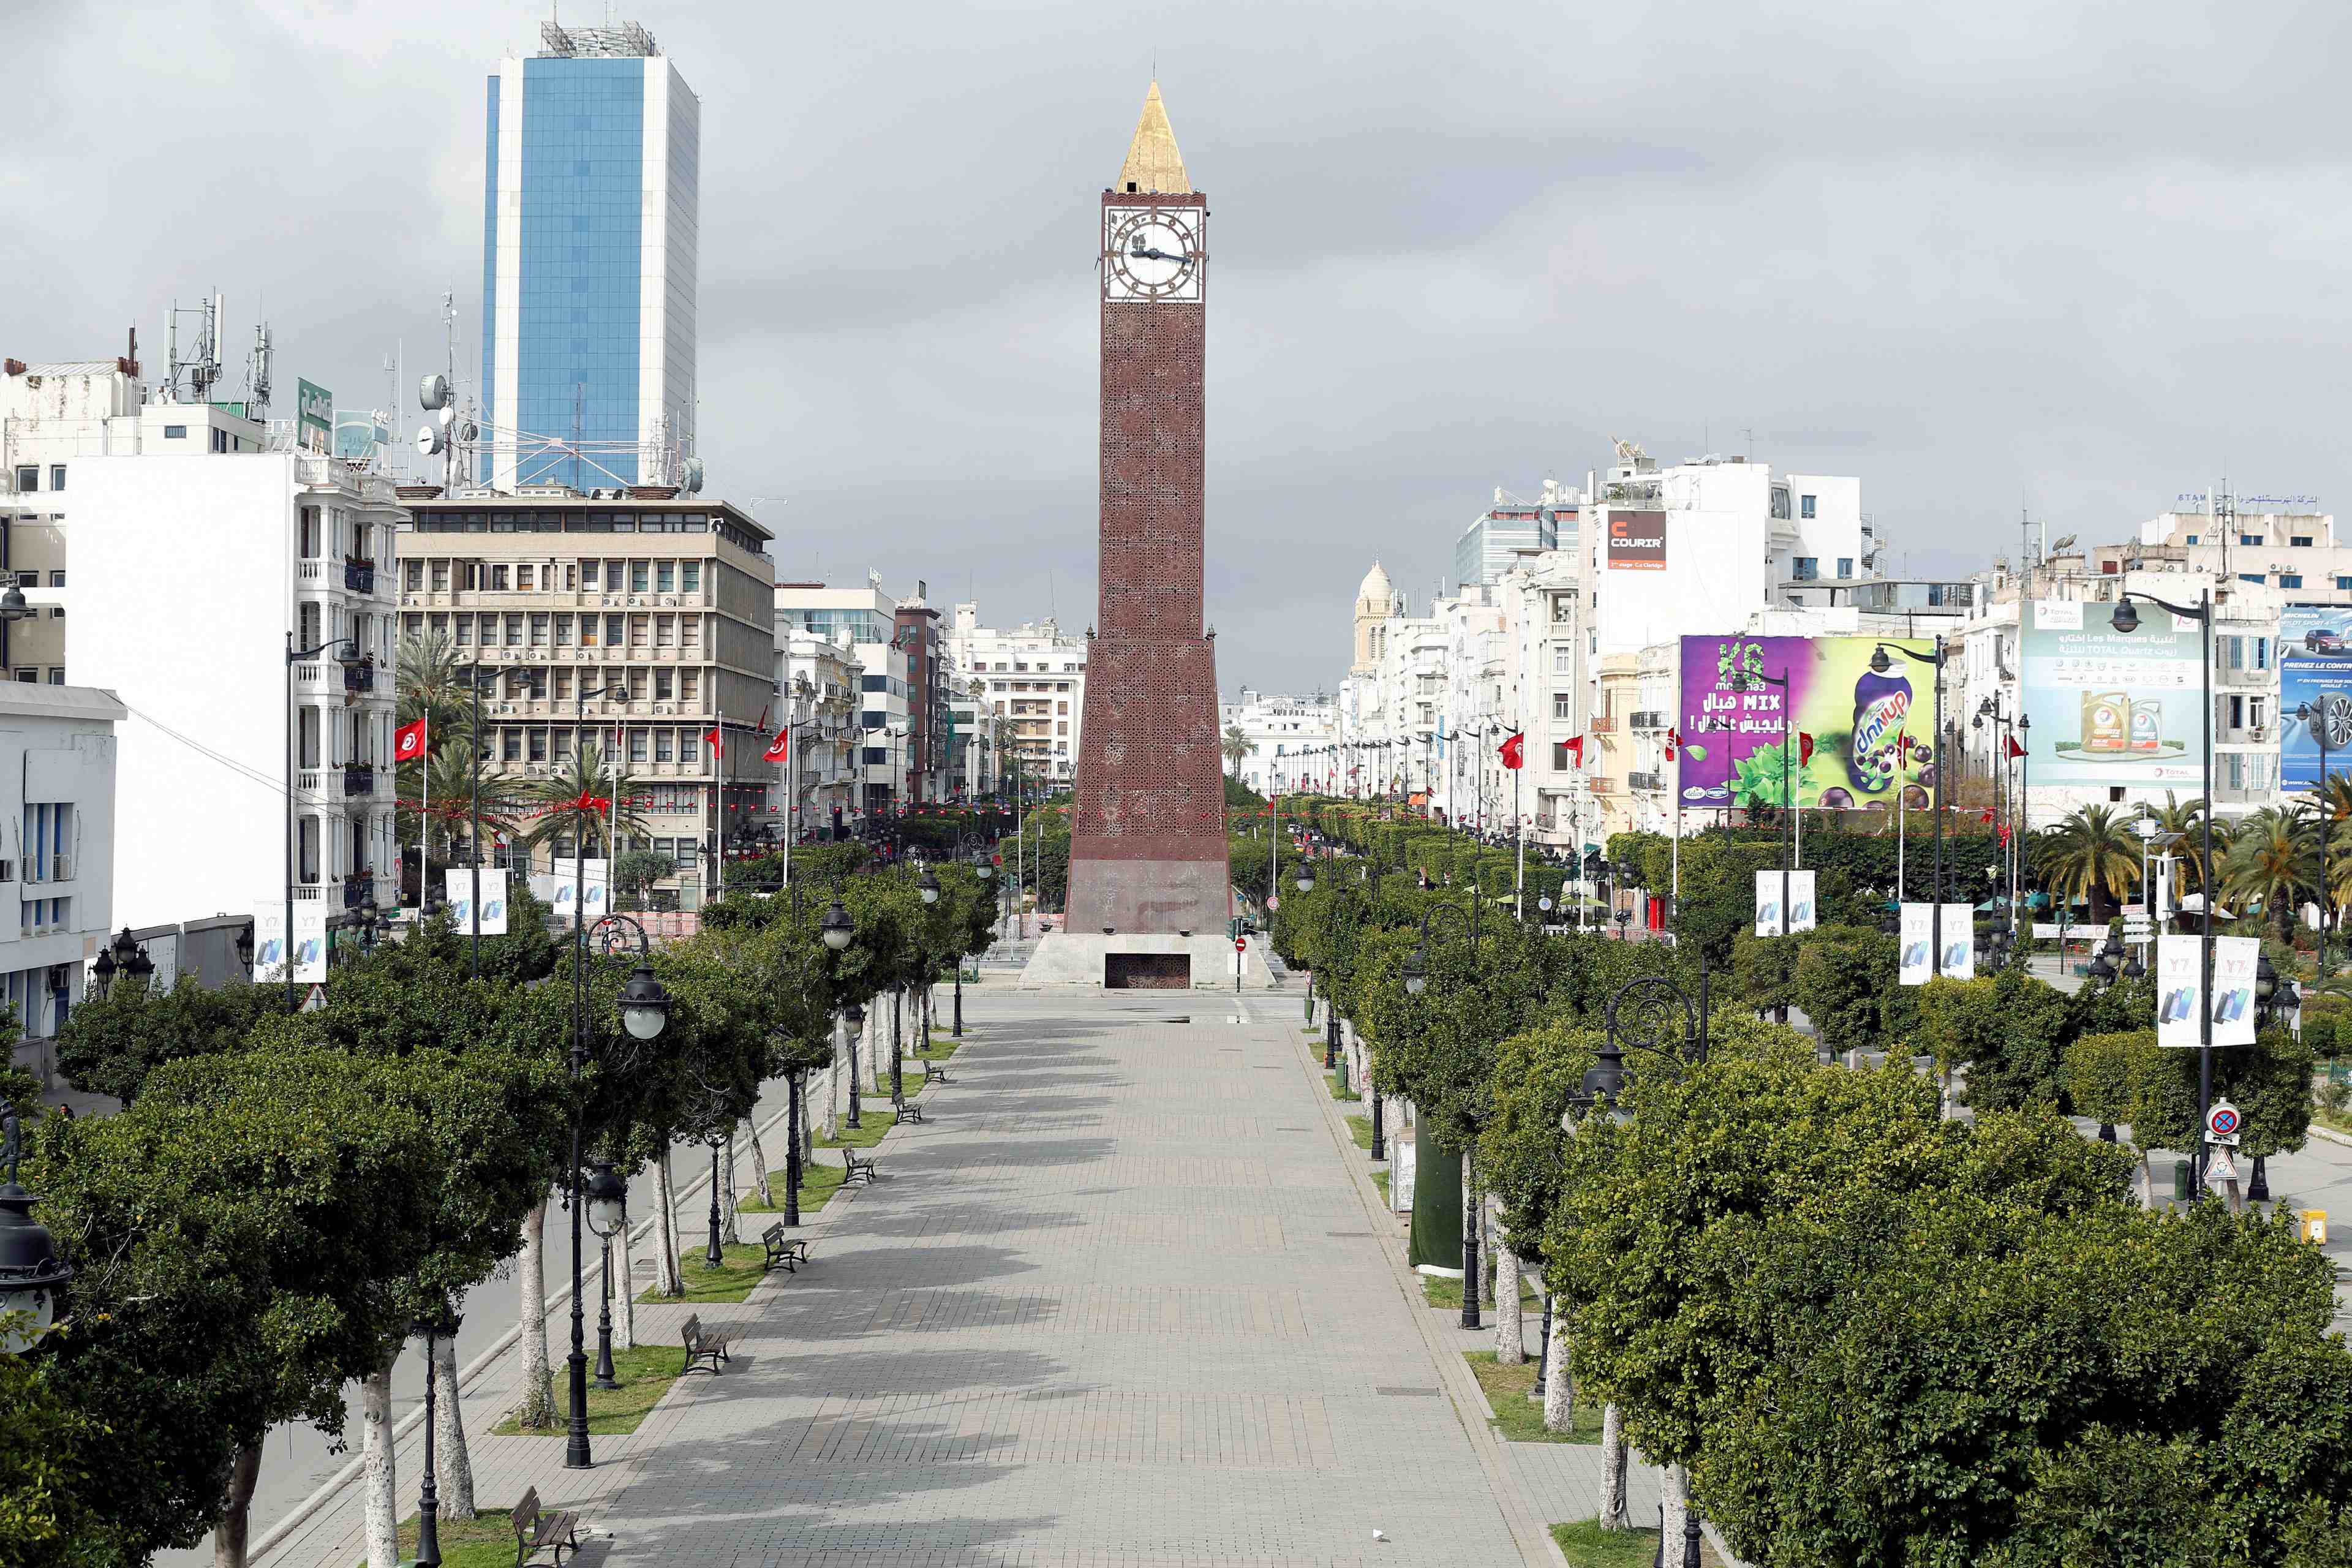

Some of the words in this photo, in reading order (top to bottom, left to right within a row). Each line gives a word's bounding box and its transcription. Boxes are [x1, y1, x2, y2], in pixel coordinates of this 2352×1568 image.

[1611, 538, 1661, 548] COURIR
[2107, 634, 2147, 645] Marques
[2087, 645, 2117, 654] TOTAL
[1717, 642, 1764, 683] K6
[1703, 693, 1736, 712] هبال
[1743, 694, 1780, 710] MIX
